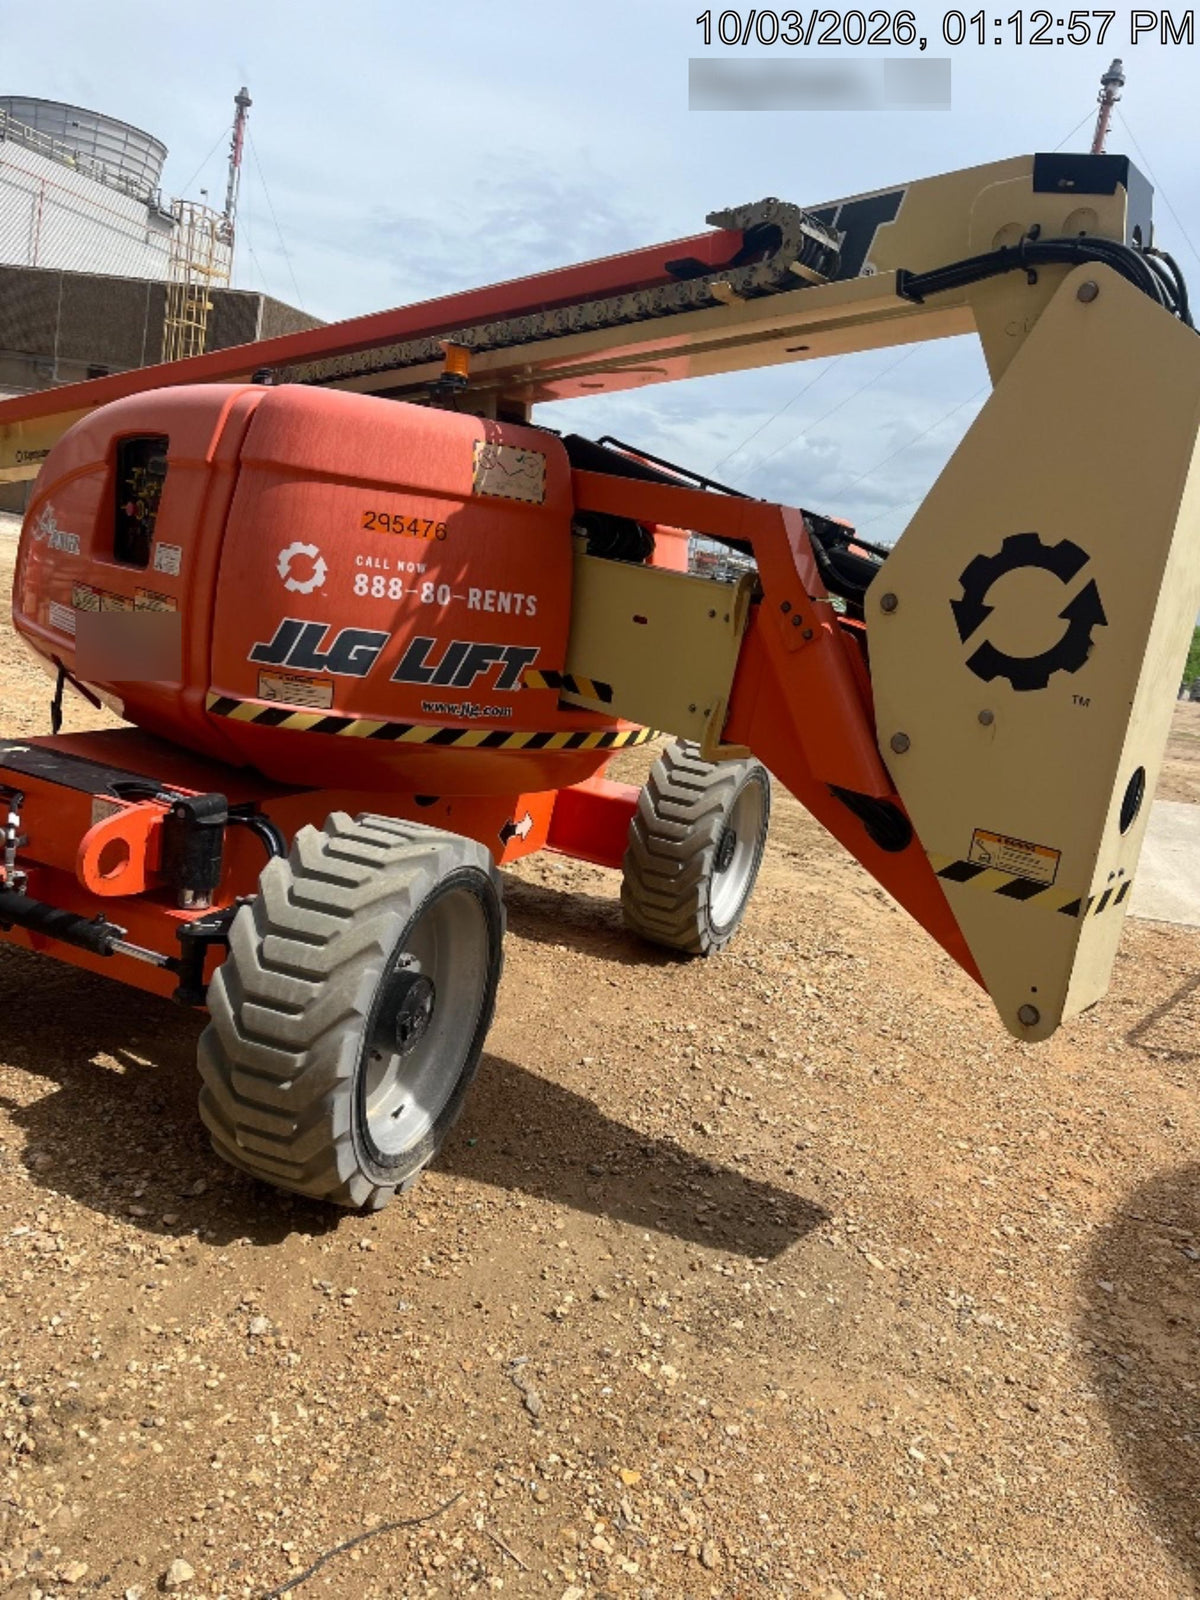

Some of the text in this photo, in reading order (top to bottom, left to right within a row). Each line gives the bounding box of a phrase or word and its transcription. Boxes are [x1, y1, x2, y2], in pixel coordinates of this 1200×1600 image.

[363, 511, 449, 541] 295476
[355, 555, 427, 573] CALL NOW
[353, 573, 538, 617] 888-80-RENTS
[247, 617, 391, 678] JLG
[390, 636, 541, 691] LIFT
[421, 700, 512, 718] www.jlg.com
